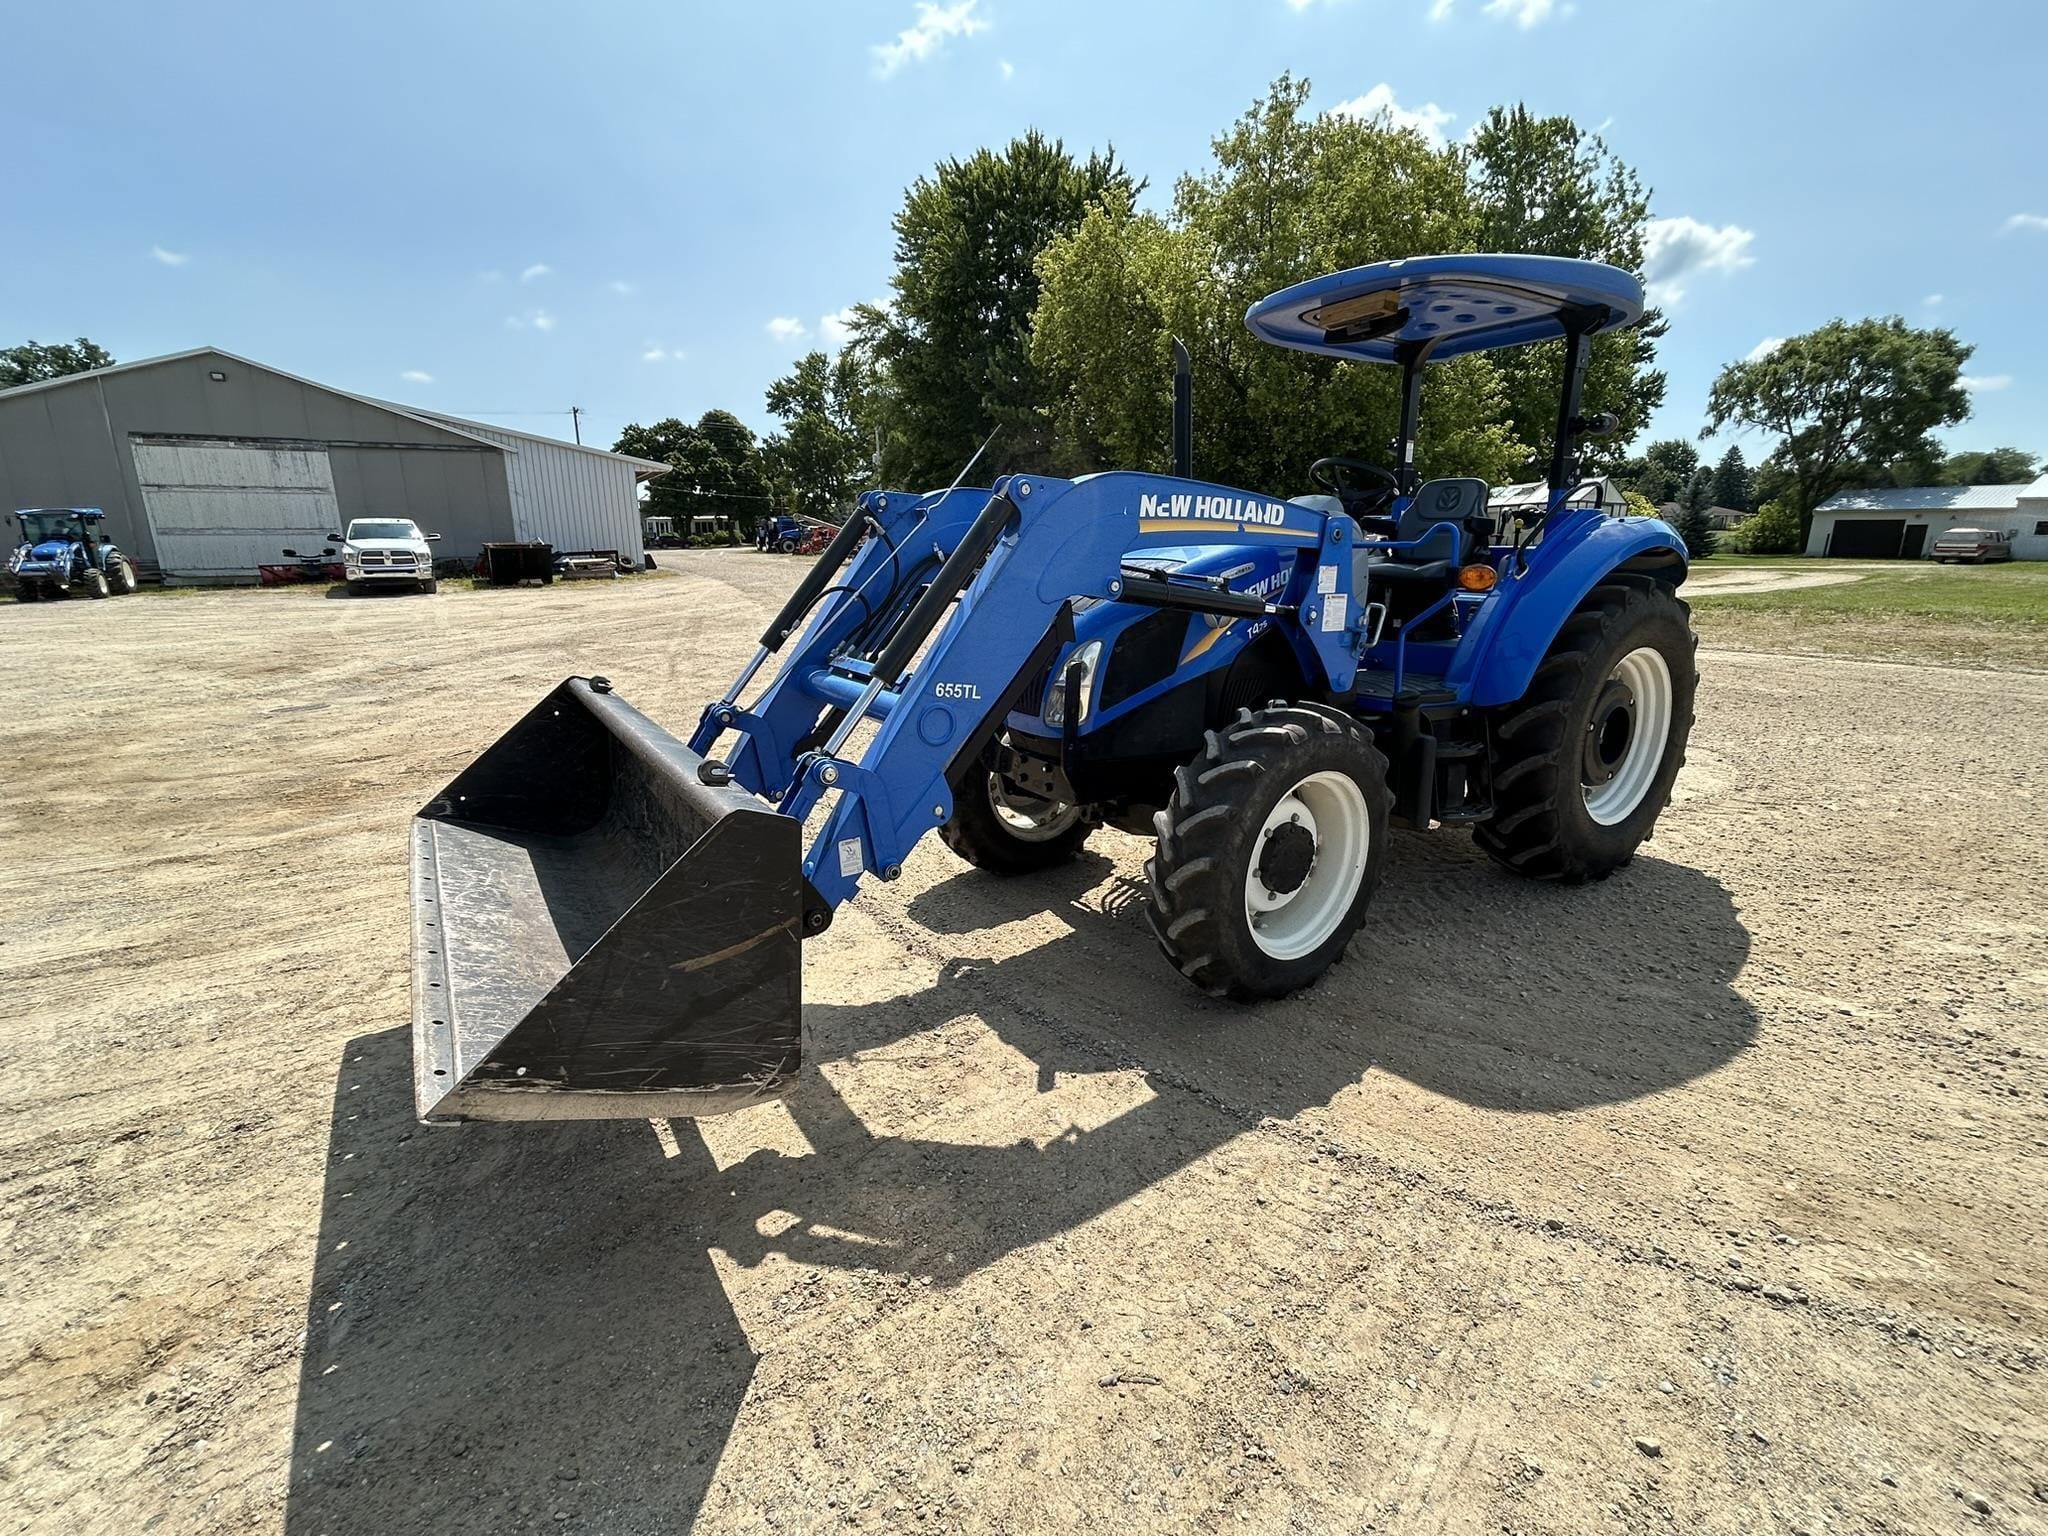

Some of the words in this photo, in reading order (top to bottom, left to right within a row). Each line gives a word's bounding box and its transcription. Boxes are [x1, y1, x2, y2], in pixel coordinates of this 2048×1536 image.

[1139, 494, 1192, 518] NEW
[1195, 495, 1285, 526] HOLLAND
[1244, 578, 1269, 597] EW
[935, 682, 982, 700] 655TL
